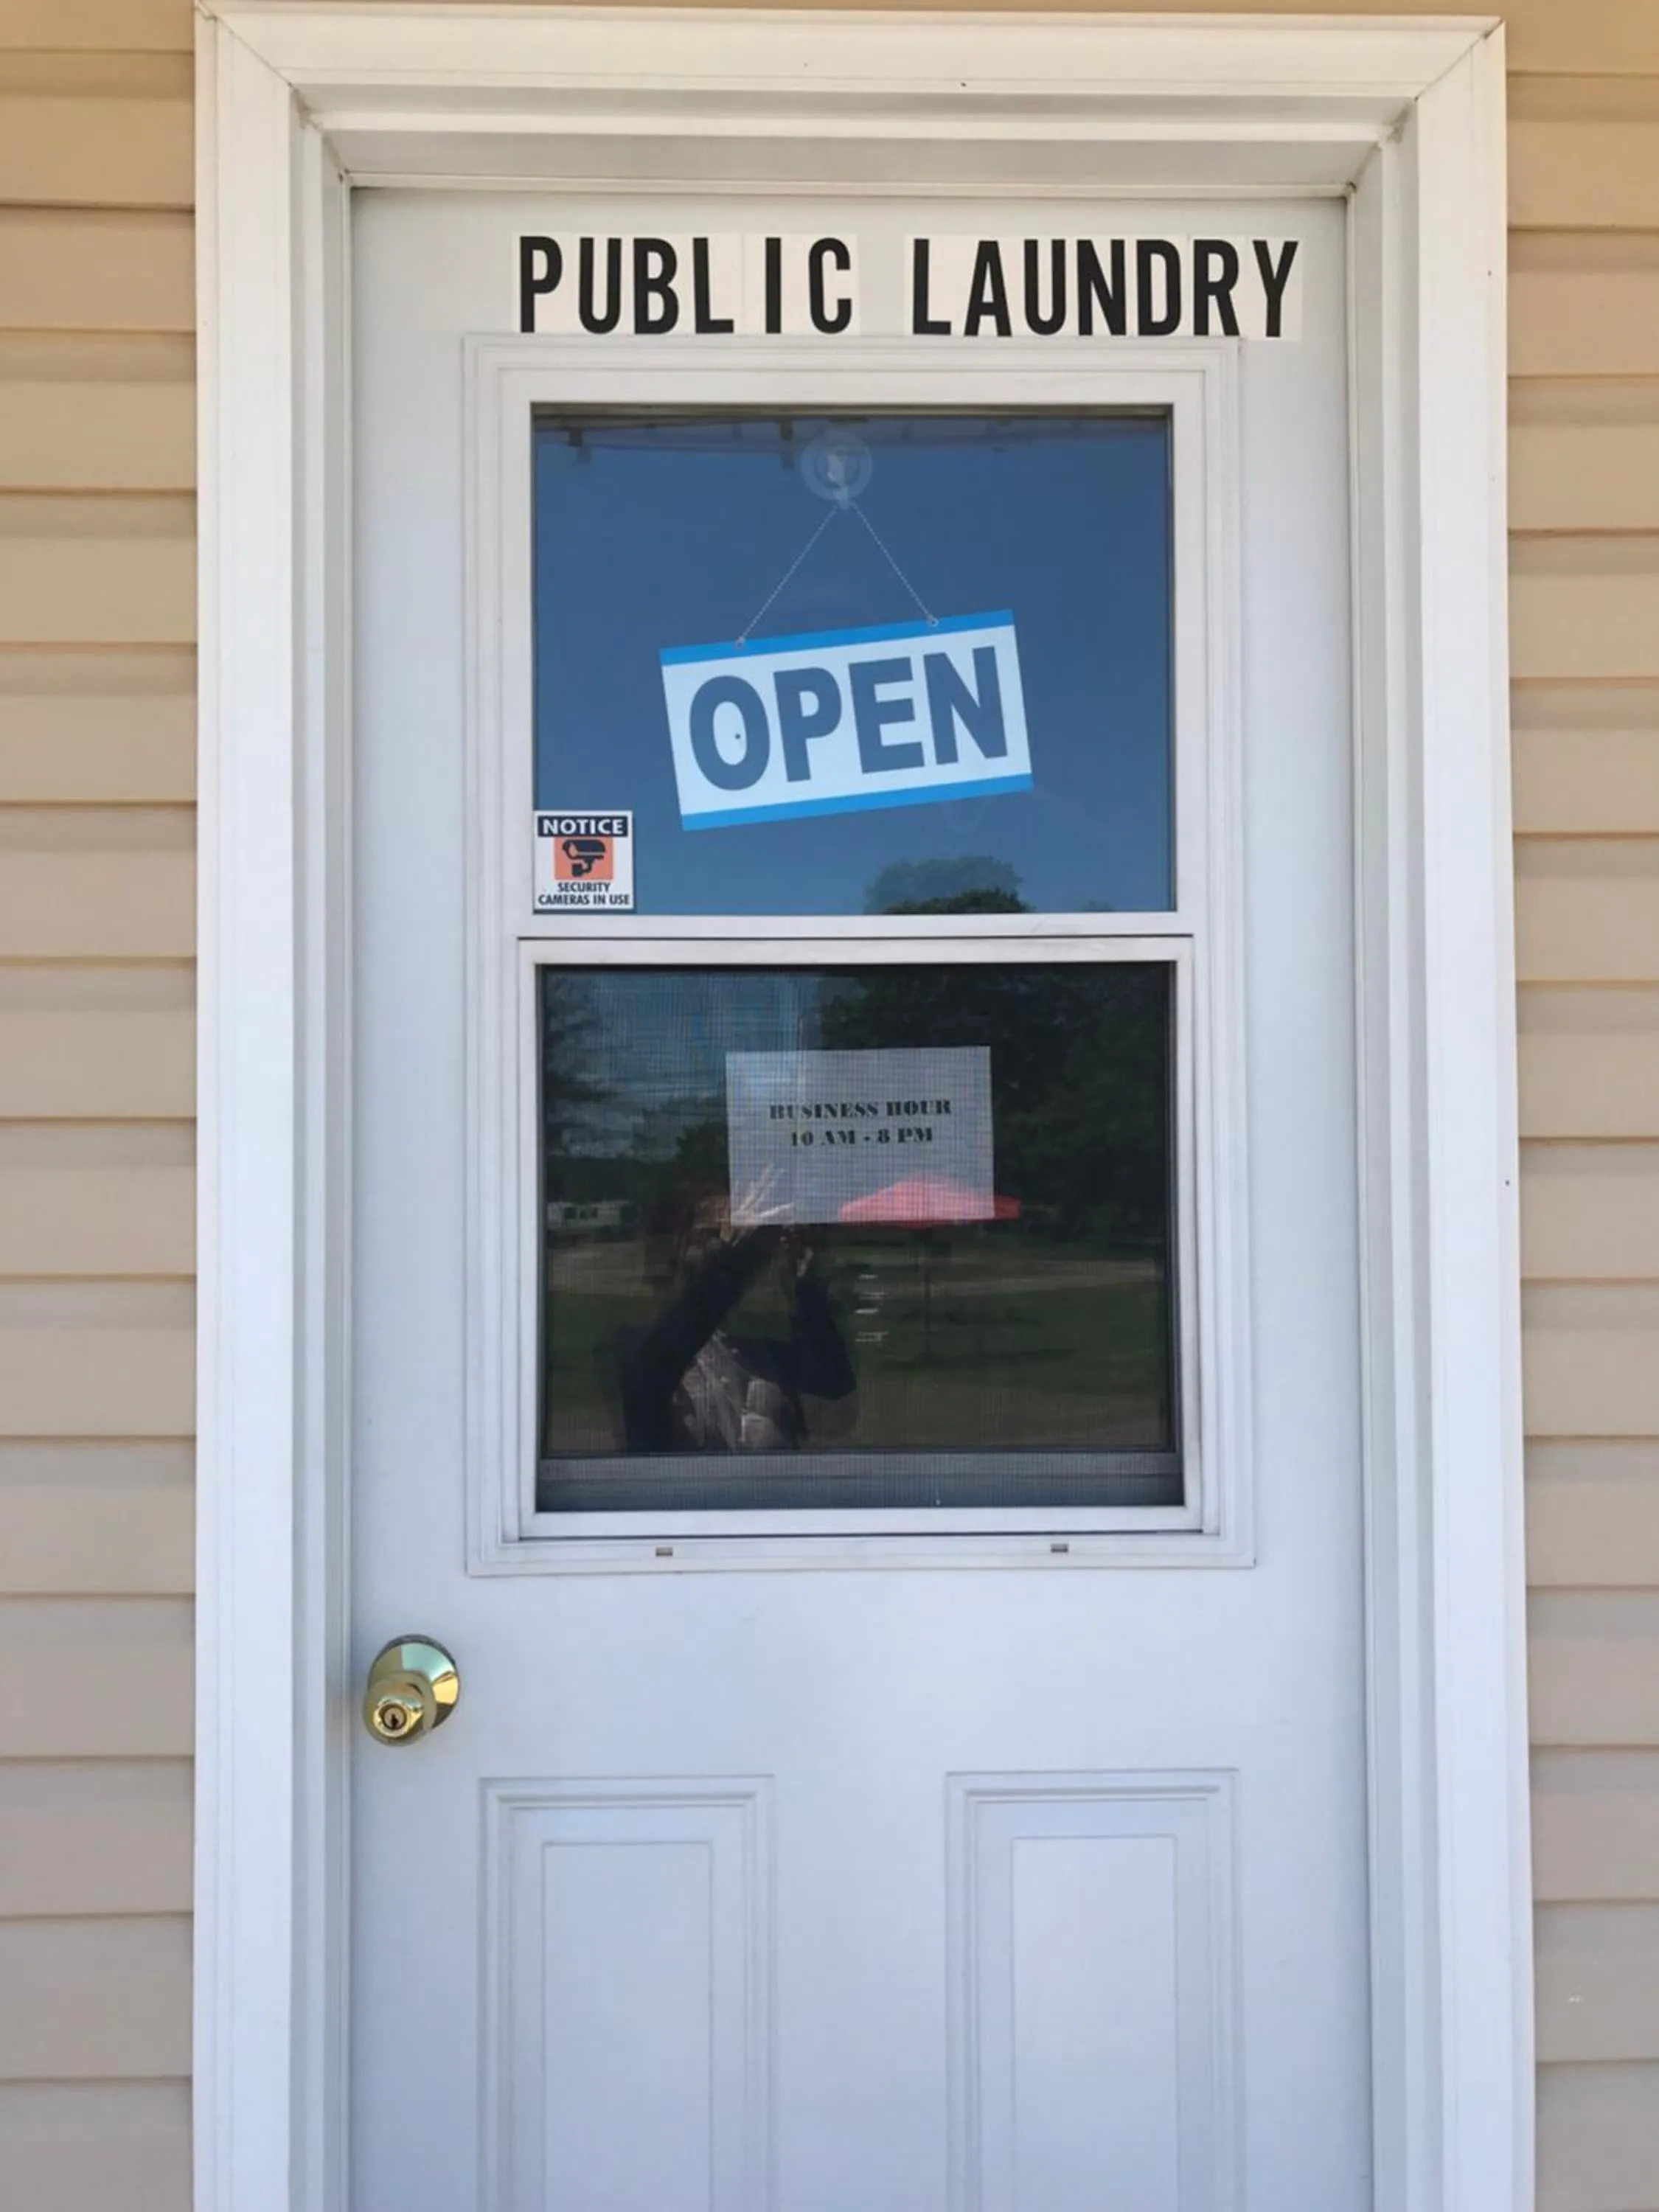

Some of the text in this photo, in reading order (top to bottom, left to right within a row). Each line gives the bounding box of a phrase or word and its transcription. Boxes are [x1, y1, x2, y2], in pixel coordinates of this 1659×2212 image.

[518, 235, 1300, 338] PUBLIC LAUNDRY
[689, 645, 1008, 791] OPEN
[542, 818, 624, 835] NOTICE
[557, 882, 611, 892] SECURITY
[538, 894, 629, 905] CAMERAS IN USE
[769, 1099, 952, 1120] BUSINESS HOUR
[790, 1131, 814, 1147] 10
[821, 1130, 855, 1146] AM
[877, 1128, 891, 1144] 8
[897, 1127, 933, 1143] PM
